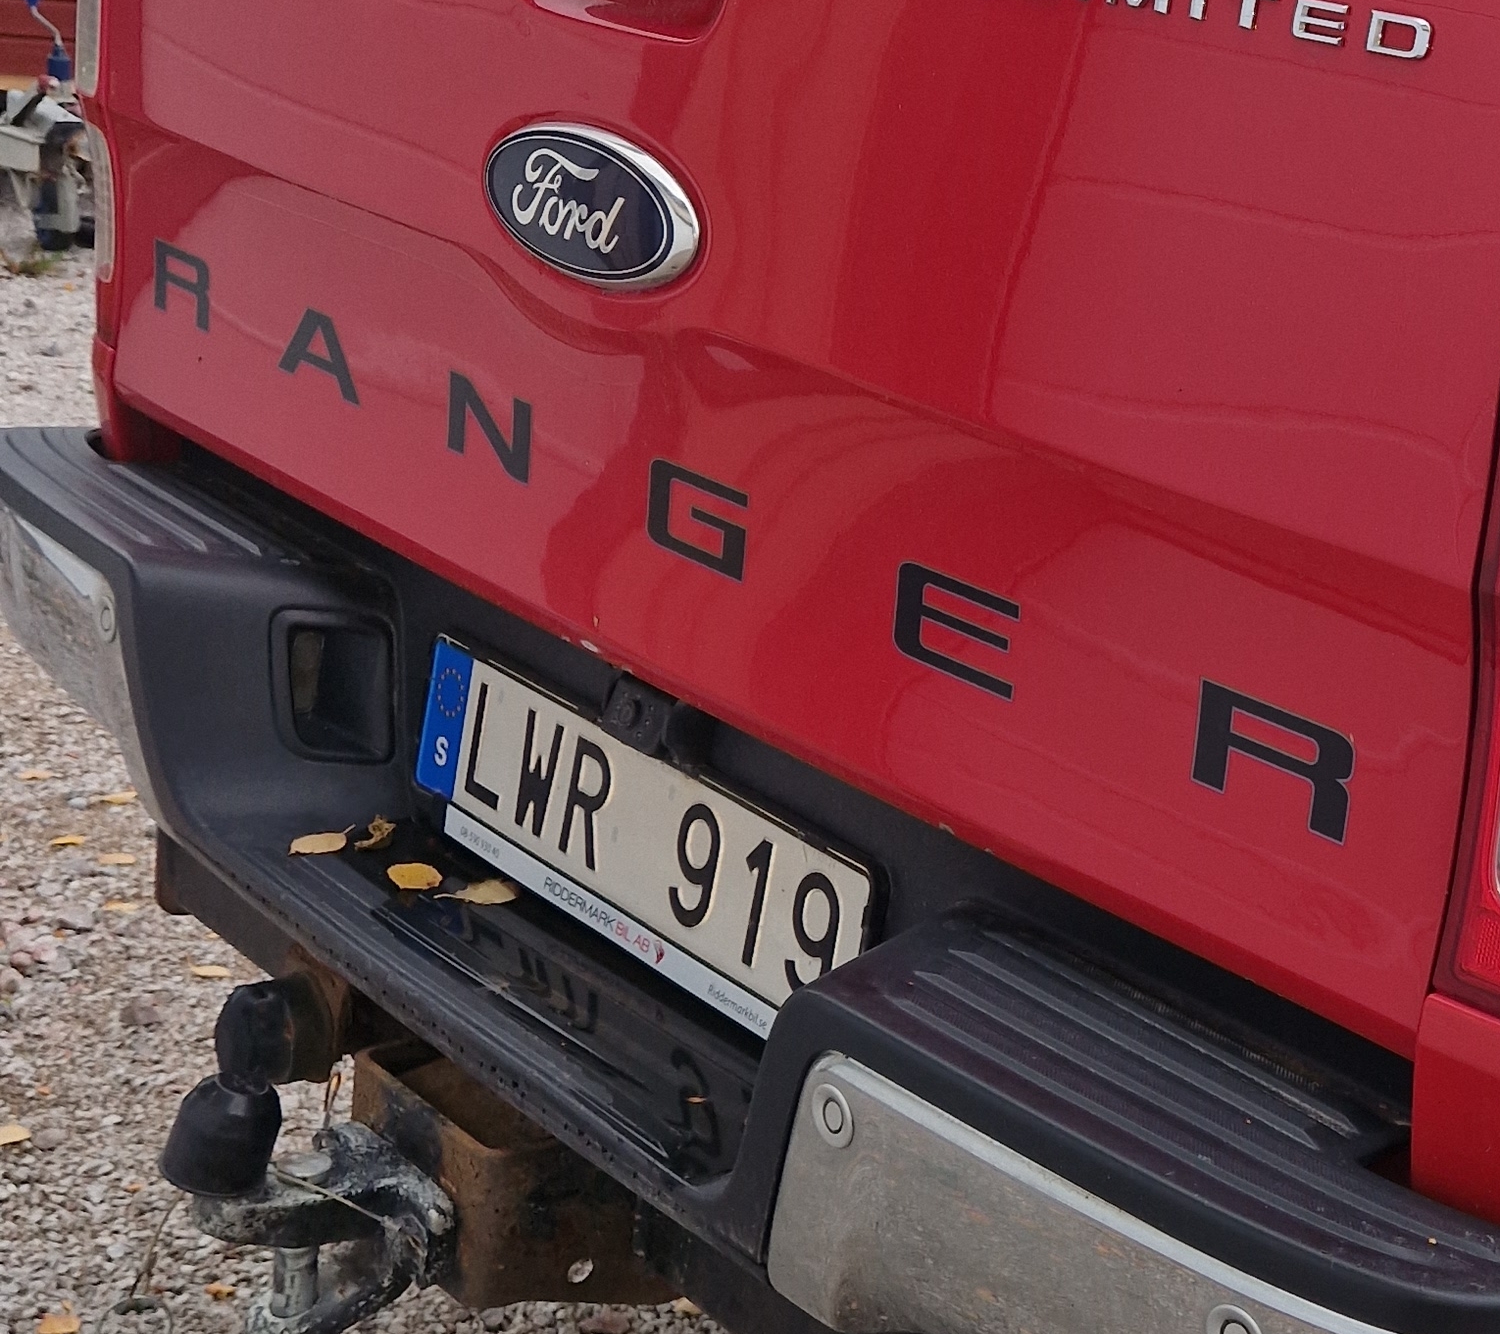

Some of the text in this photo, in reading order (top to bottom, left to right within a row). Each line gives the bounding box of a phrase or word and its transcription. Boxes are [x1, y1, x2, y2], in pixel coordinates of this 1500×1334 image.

[512, 148, 625, 254] Ford
[154, 238, 1355, 845] RANGER
[434, 736, 449, 766] S
[465, 682, 840, 992] LWR 919
[544, 876, 651, 954] RIDDERMARK BIL AB
[707, 983, 768, 1031] Riddermarkbil.se
